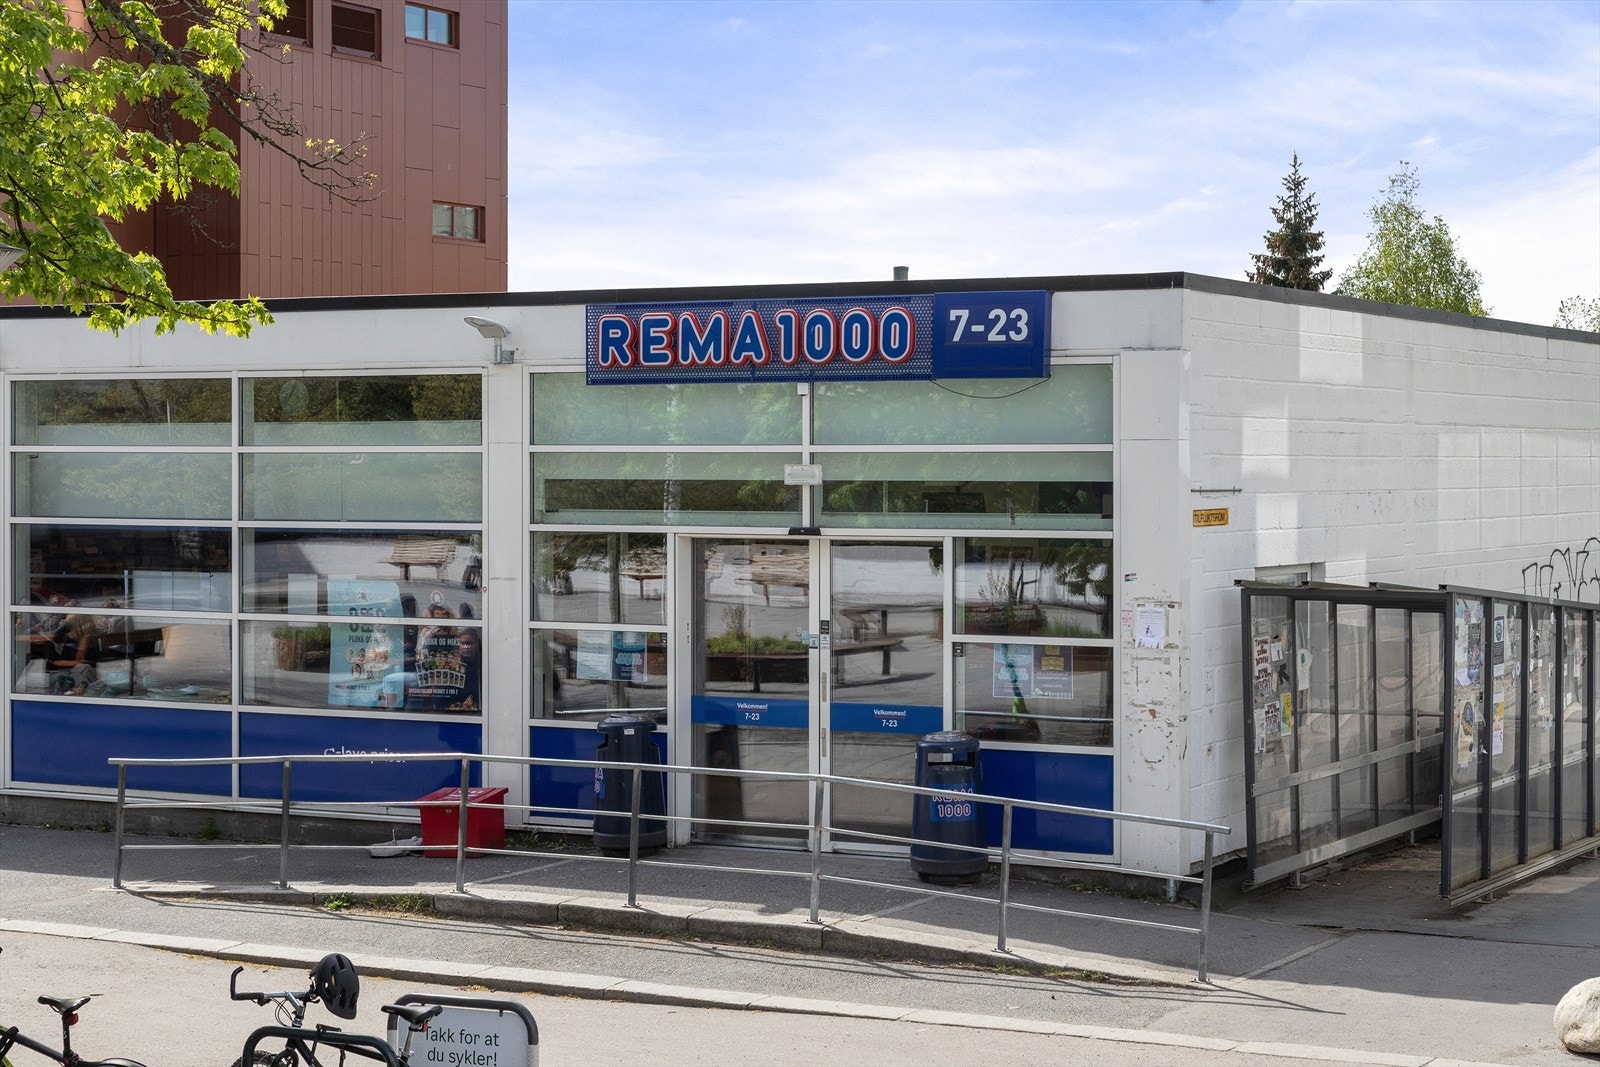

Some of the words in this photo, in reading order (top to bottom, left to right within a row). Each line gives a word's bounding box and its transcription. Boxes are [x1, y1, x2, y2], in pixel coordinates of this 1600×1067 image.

[949, 308, 1028, 342] 7-23
[598, 310, 771, 369] REMA
[774, 306, 916, 366] 1000
[438, 637, 447, 646] OG
[736, 702, 769, 710] Velkommen!
[744, 712, 761, 721] 7-23
[873, 708, 907, 717] Velkommen!
[881, 719, 898, 728] 7-23
[937, 803, 972, 818] 1000
[424, 1025, 455, 1043] Takk
[459, 1028, 481, 1045] for
[484, 1033, 500, 1047] at
[427, 1047, 444, 1062] du
[448, 1049, 497, 1067] sykler!
